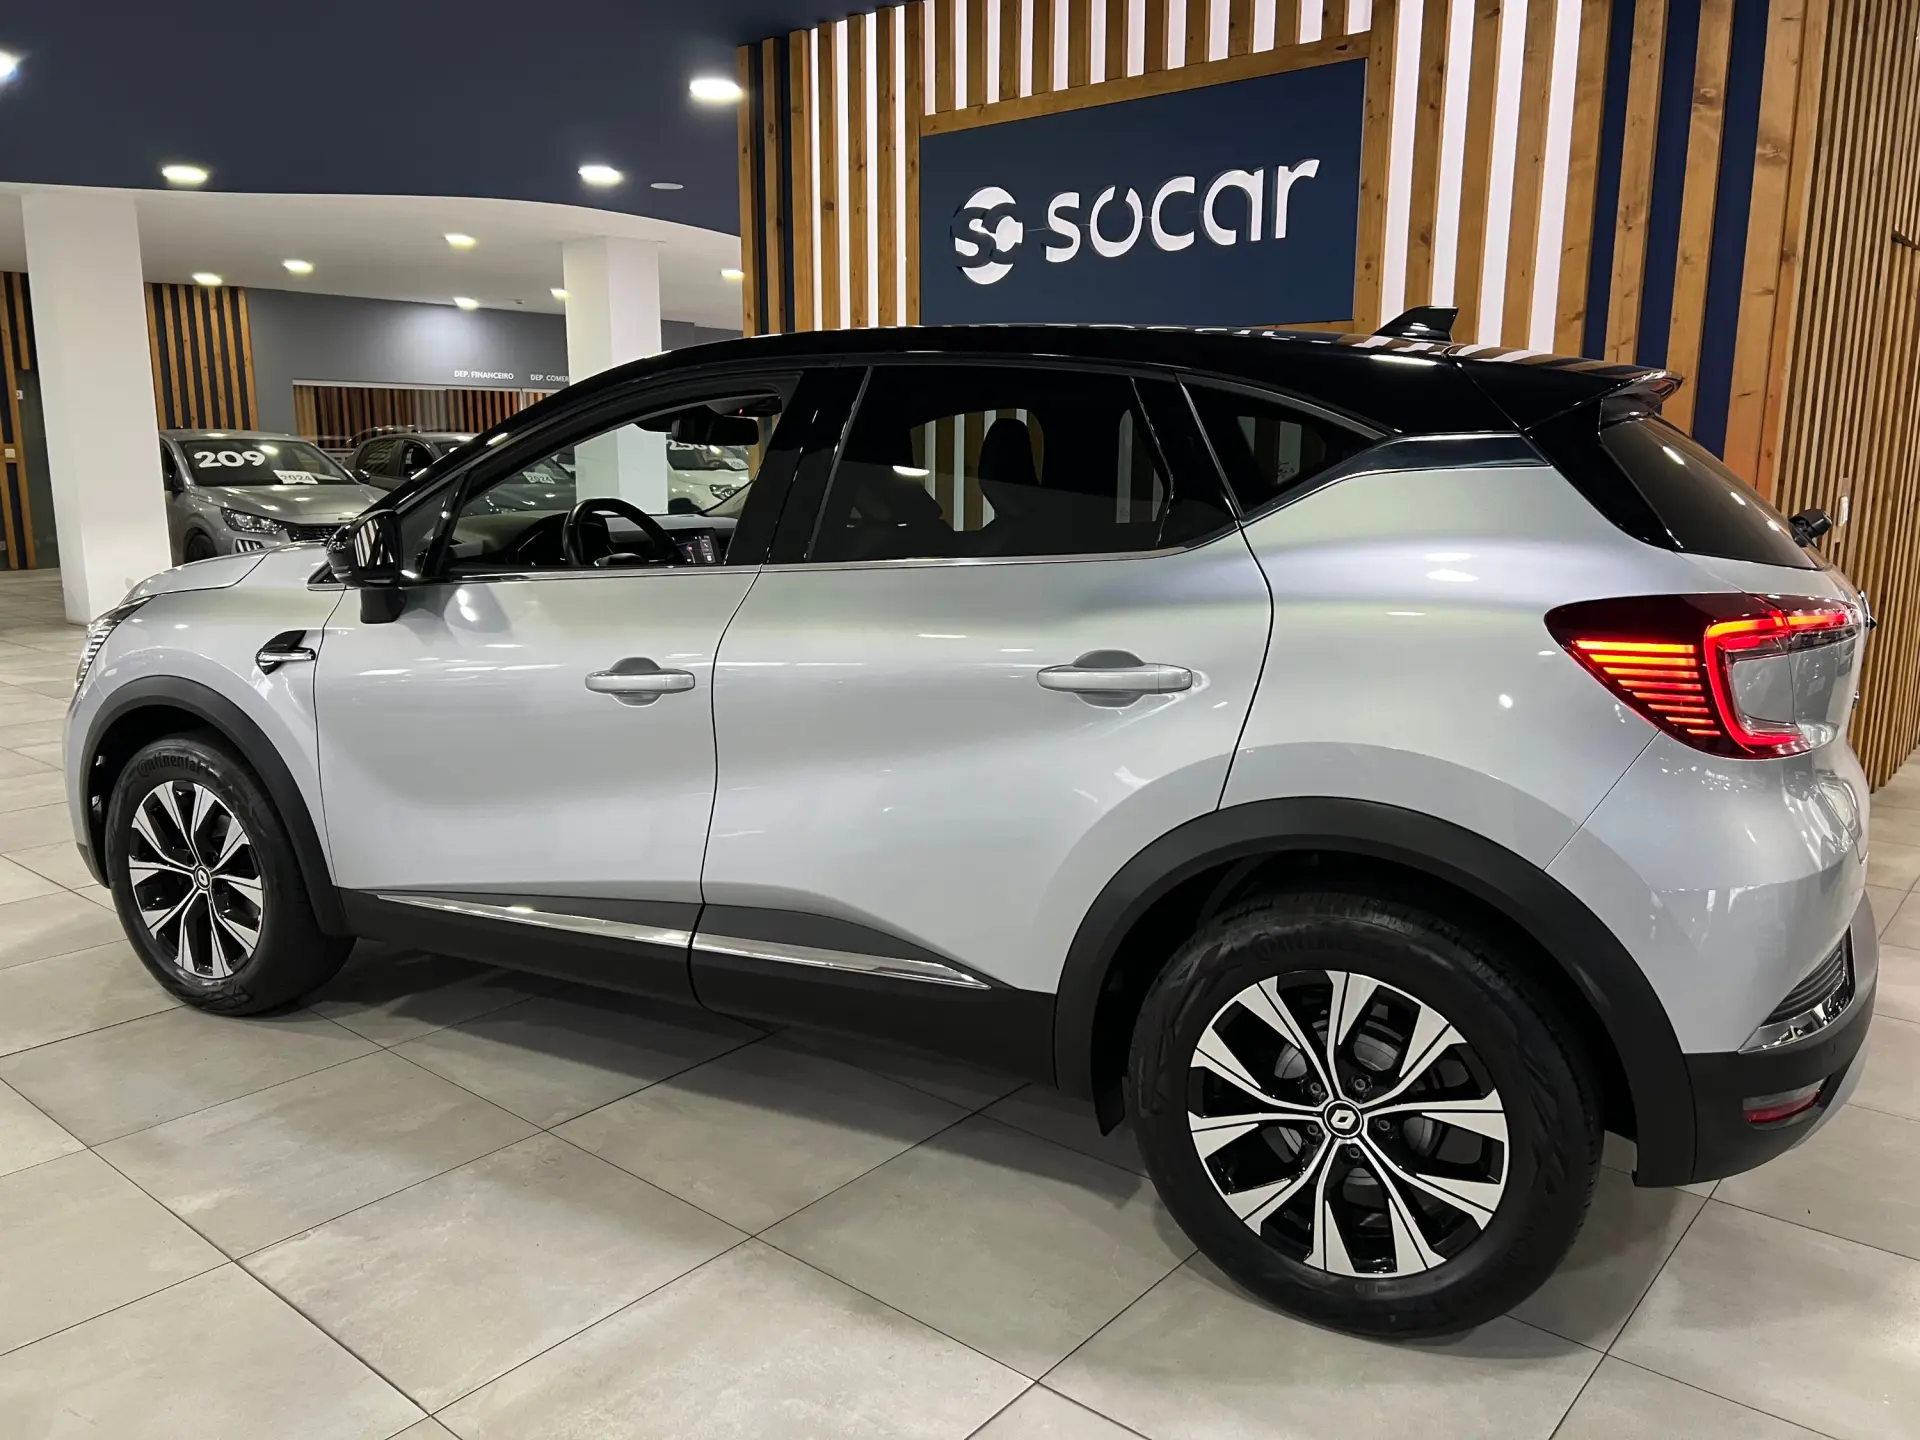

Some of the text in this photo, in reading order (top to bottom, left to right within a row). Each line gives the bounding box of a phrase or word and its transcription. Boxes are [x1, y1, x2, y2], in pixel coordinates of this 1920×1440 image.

[1044, 158, 1321, 263] socar
[454, 370, 515, 380] DEP. FINANCEIRO
[530, 374, 545, 382] DEP.
[194, 450, 266, 468] 209
[279, 474, 314, 482] 2024
